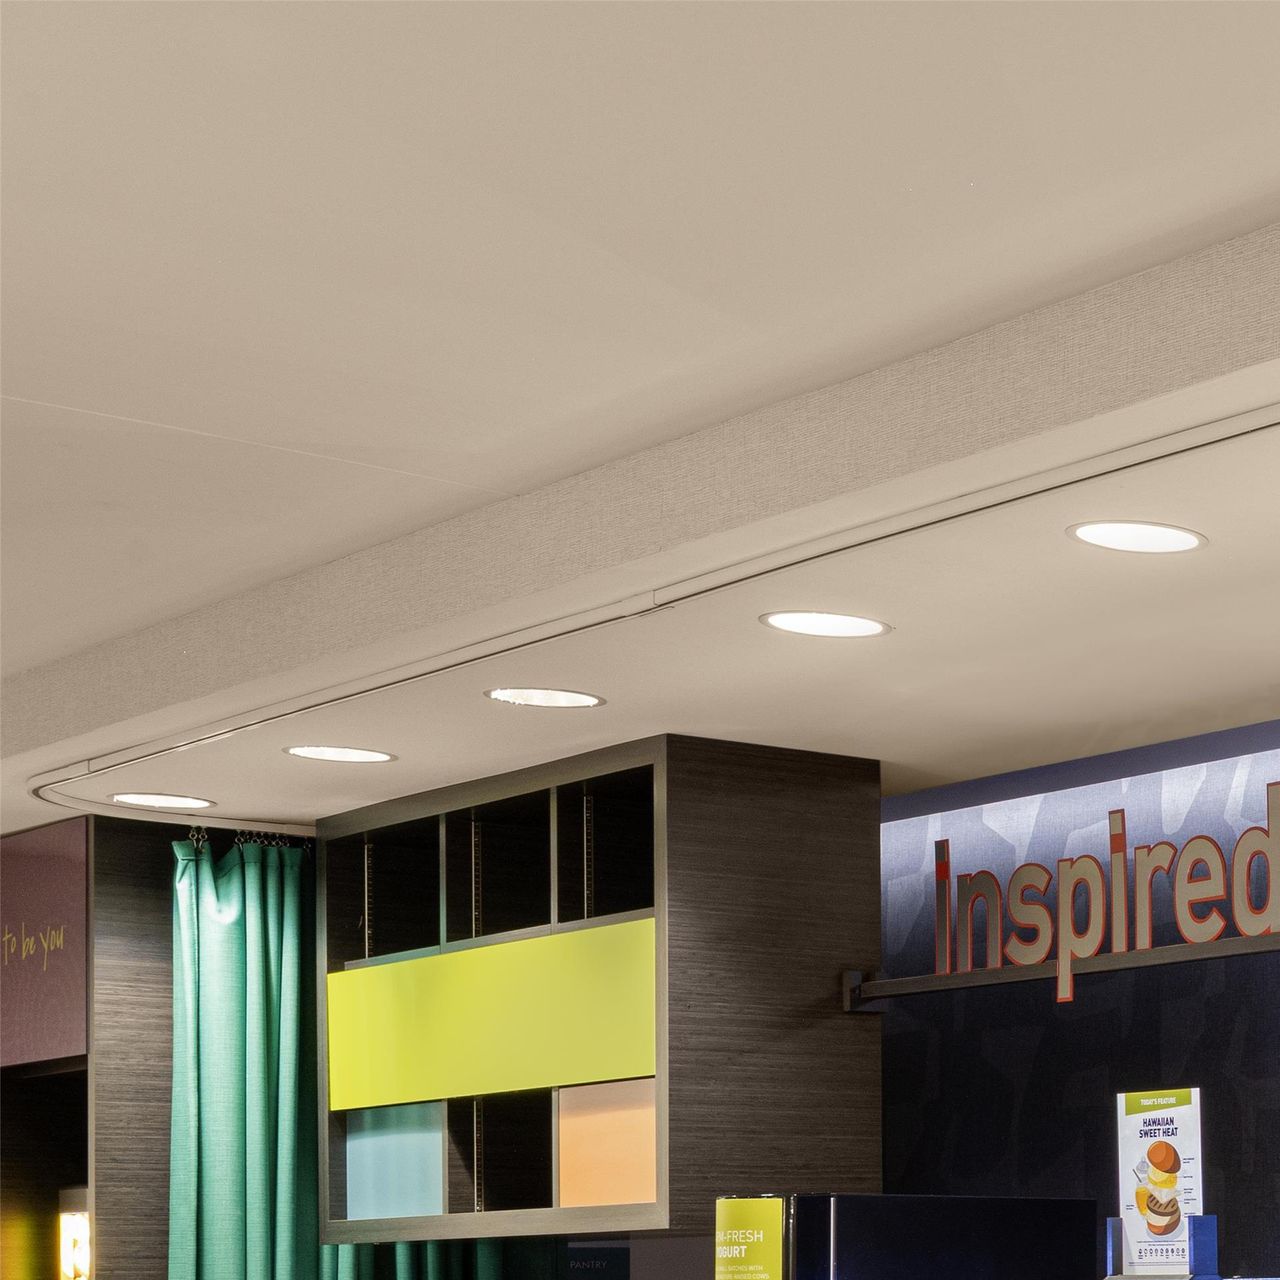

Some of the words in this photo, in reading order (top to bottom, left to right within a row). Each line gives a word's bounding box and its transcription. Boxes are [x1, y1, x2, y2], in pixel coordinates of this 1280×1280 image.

[3, 925, 16, 965] to
[22, 922, 36, 960] be
[40, 926, 64, 971] you
[1143, 1117, 1174, 1127] HAWAIIAN
[1139, 1128, 1161, 1138] SWEET
[1163, 1127, 1178, 1137] HEAT
[570, 1260, 607, 1269] PANTRY
